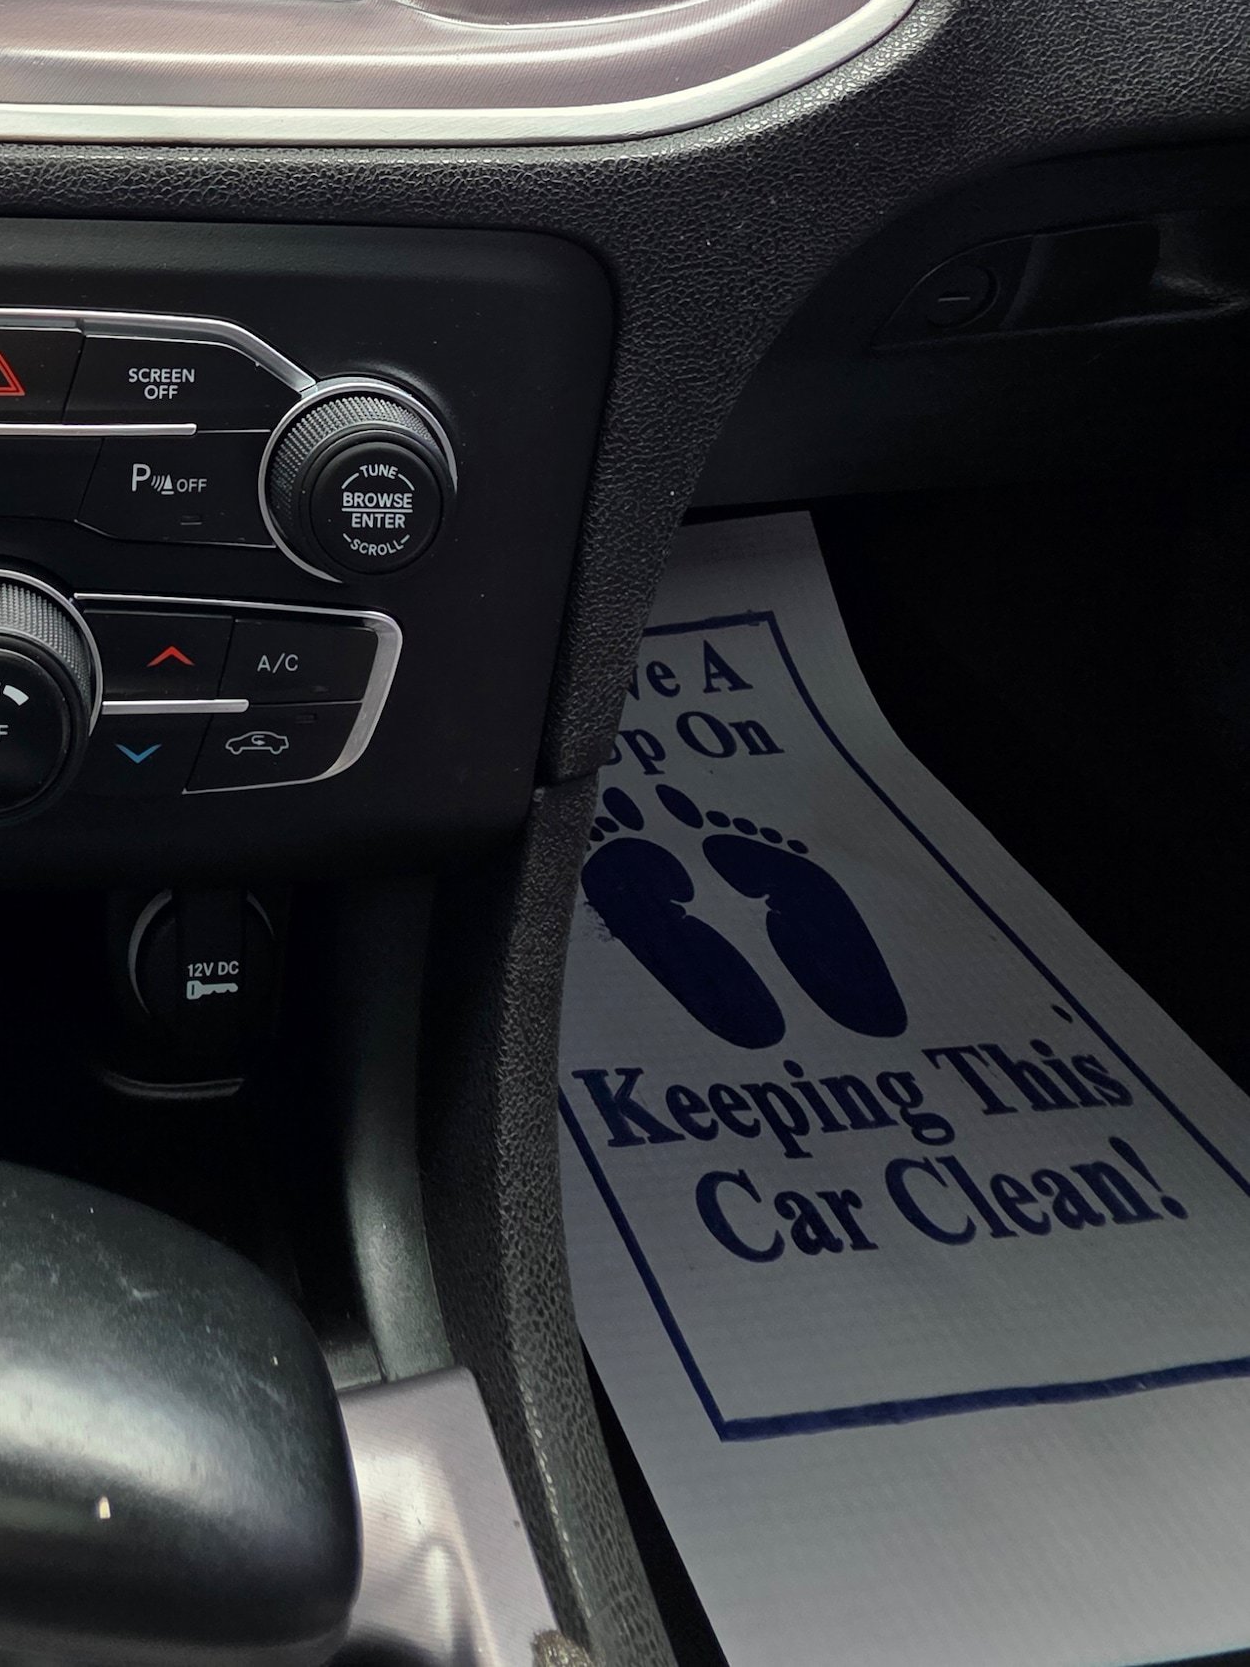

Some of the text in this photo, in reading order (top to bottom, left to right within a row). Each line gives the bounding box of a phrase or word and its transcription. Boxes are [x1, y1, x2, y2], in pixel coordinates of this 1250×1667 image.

[128, 367, 195, 383] SCREEN
[144, 385, 179, 400] OFF
[131, 463, 208, 492] P OFF
[359, 463, 399, 480] TUNE
[342, 492, 413, 508] BROWSE
[351, 513, 406, 529] ENTER
[350, 538, 405, 556] SCROLL
[257, 653, 299, 674] A/C
[703, 639, 754, 694] A
[676, 710, 785, 759] On
[187, 960, 240, 978] 12V DC
[571, 1038, 1134, 1159] Keeping This
[695, 1135, 1189, 1264] Car Clean!
